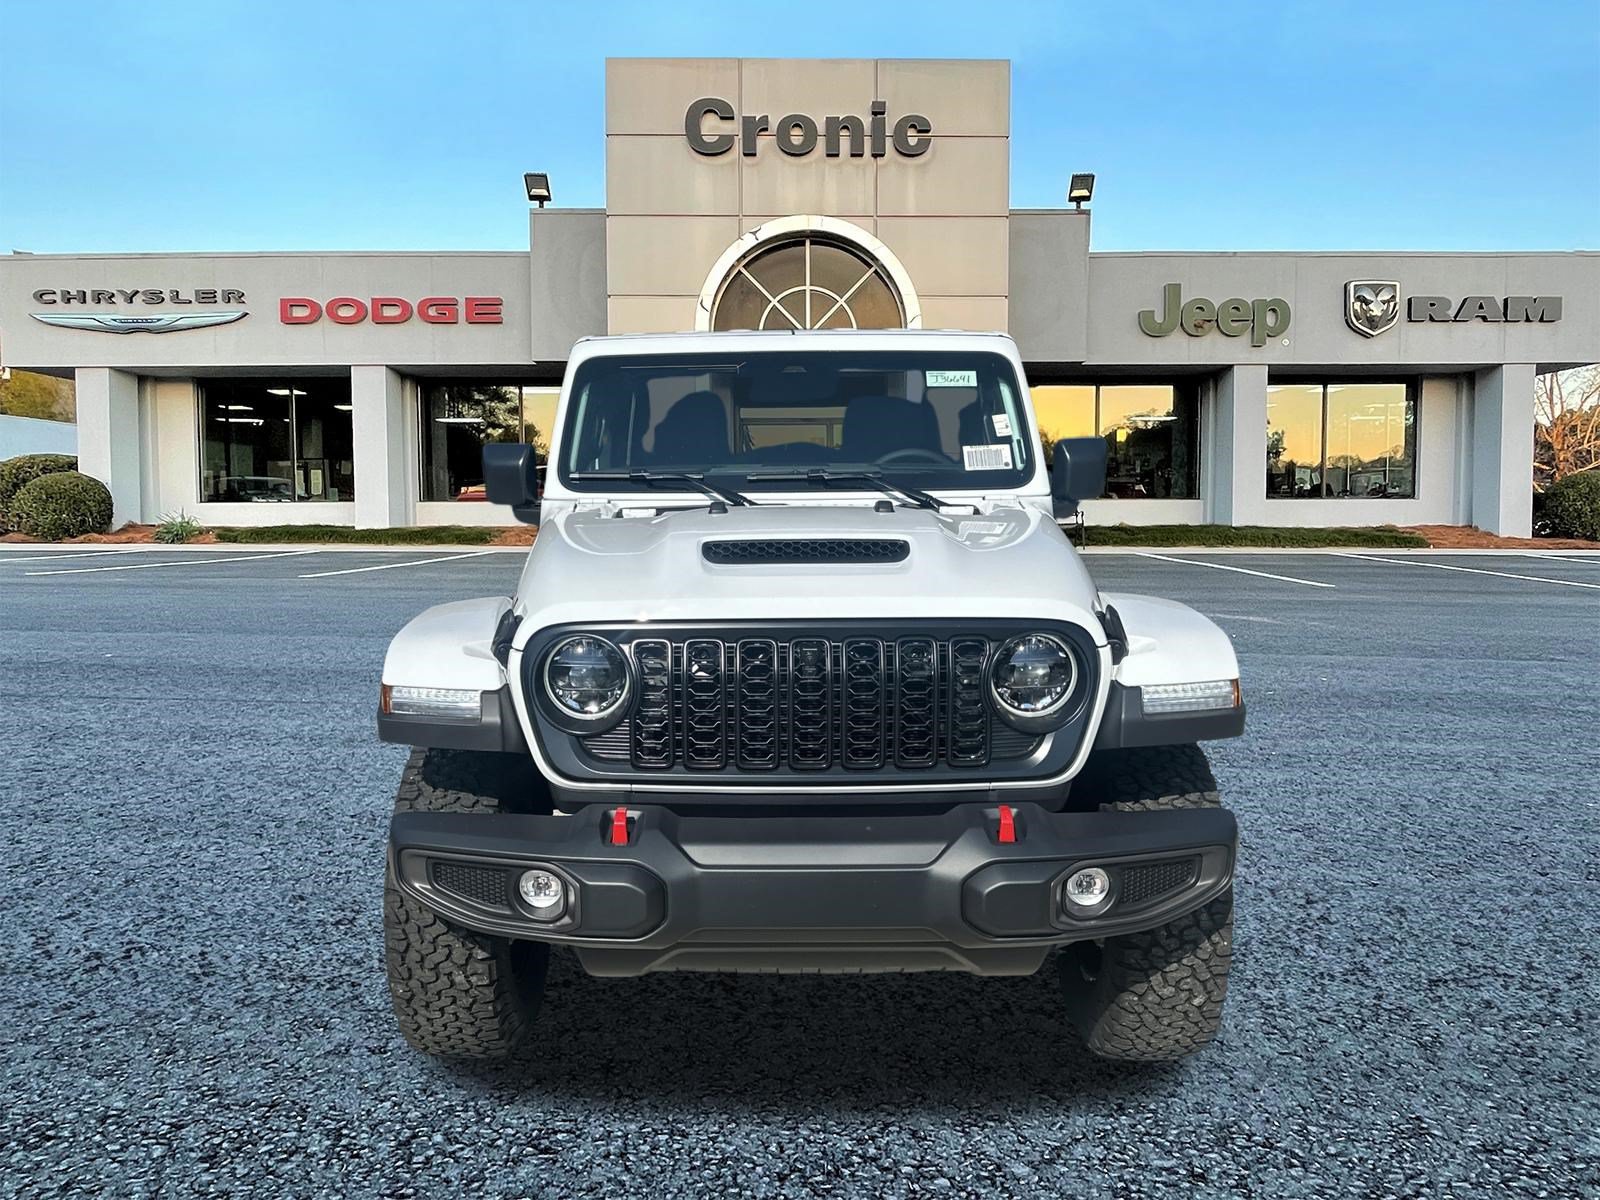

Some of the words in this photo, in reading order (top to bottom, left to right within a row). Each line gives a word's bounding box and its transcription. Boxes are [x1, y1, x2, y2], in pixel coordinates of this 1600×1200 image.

[685, 97, 932, 157] Cronic
[32, 289, 246, 304] CHRYSLER
[1408, 296, 1562, 322] RAM
[280, 297, 503, 324] DODGE
[1138, 283, 1291, 347] Jeep
